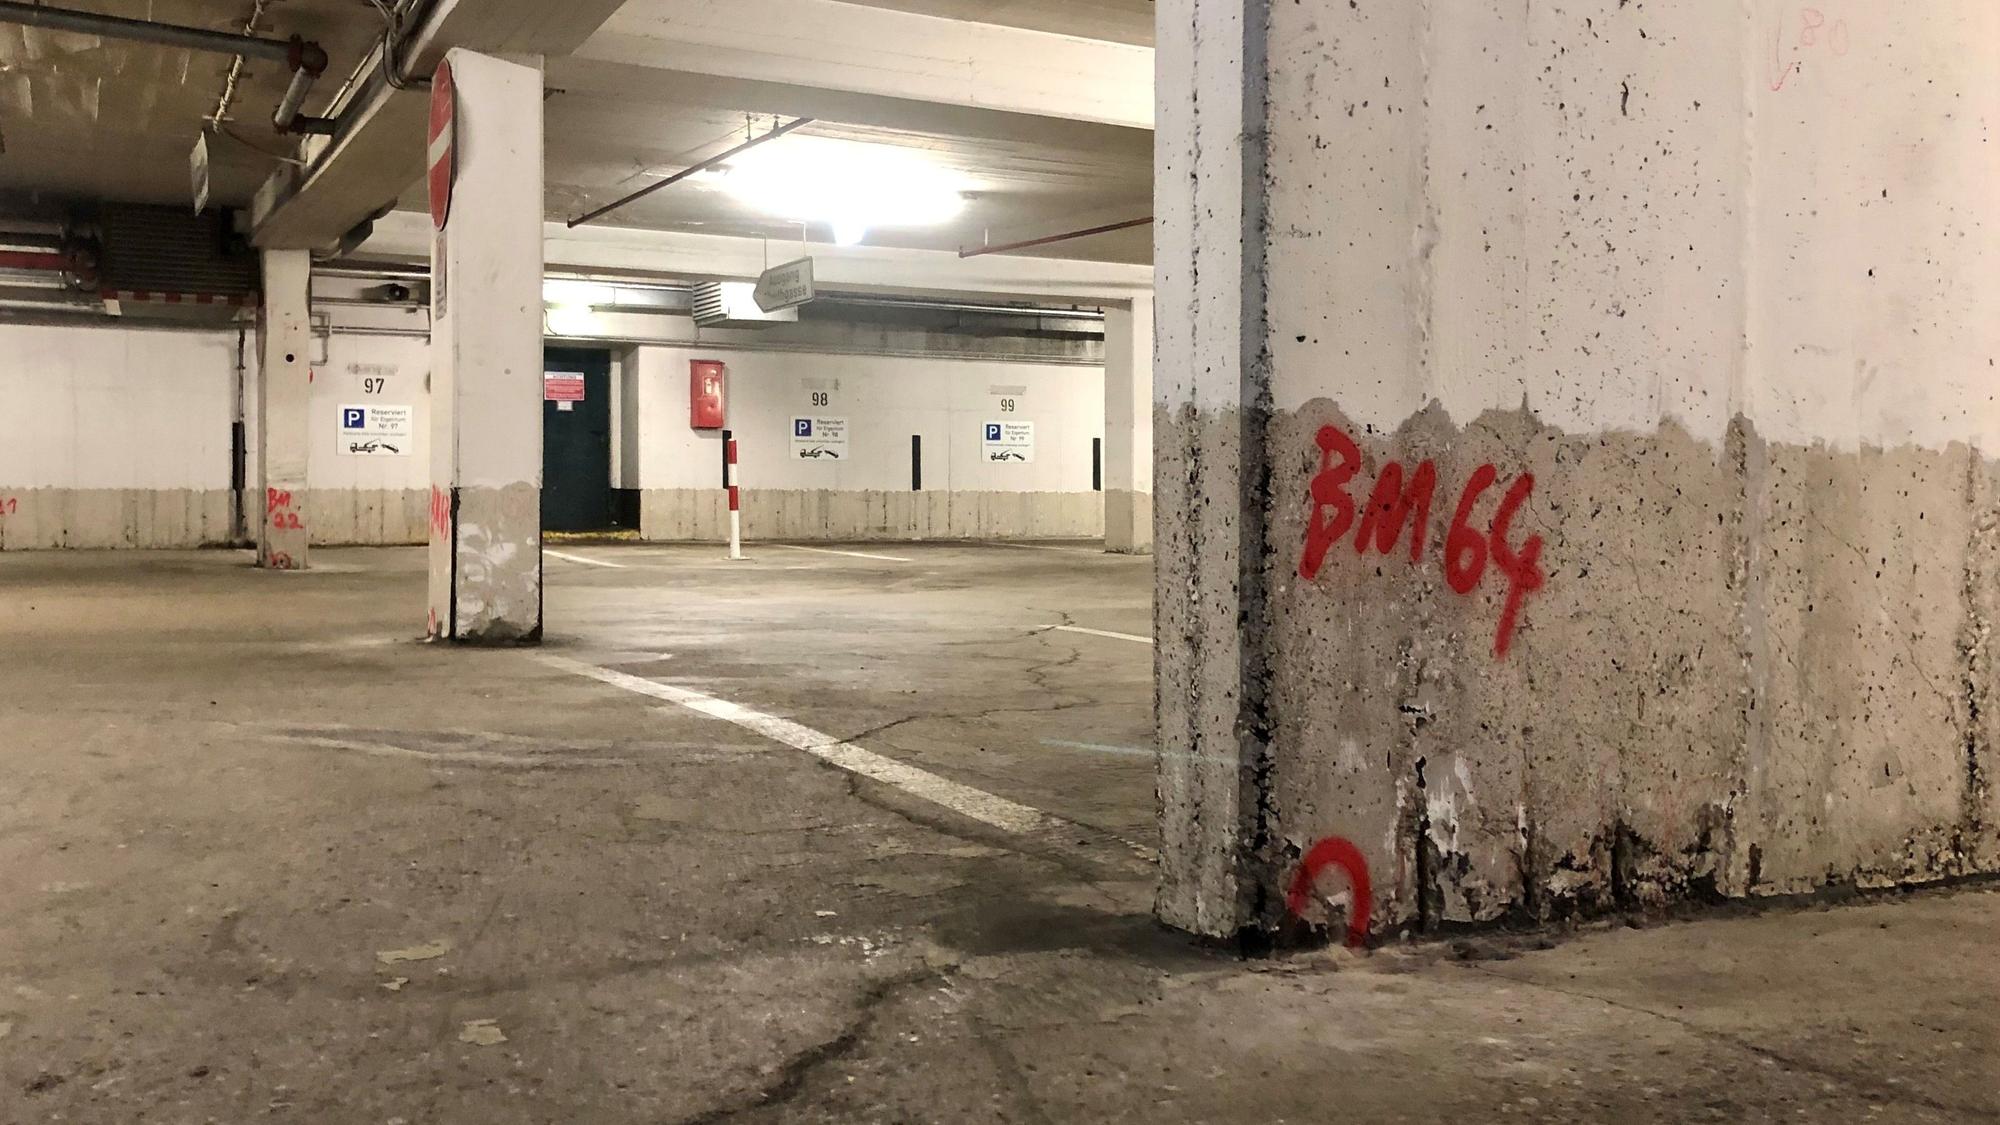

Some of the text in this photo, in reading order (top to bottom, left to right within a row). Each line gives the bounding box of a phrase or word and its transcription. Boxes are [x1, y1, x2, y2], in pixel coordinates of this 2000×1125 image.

[364, 378, 385, 394] 97
[812, 392, 828, 406] 98
[1000, 398, 1015, 412] 99
[348, 410, 360, 426] P
[798, 421, 808, 435] P
[989, 425, 998, 439] P
